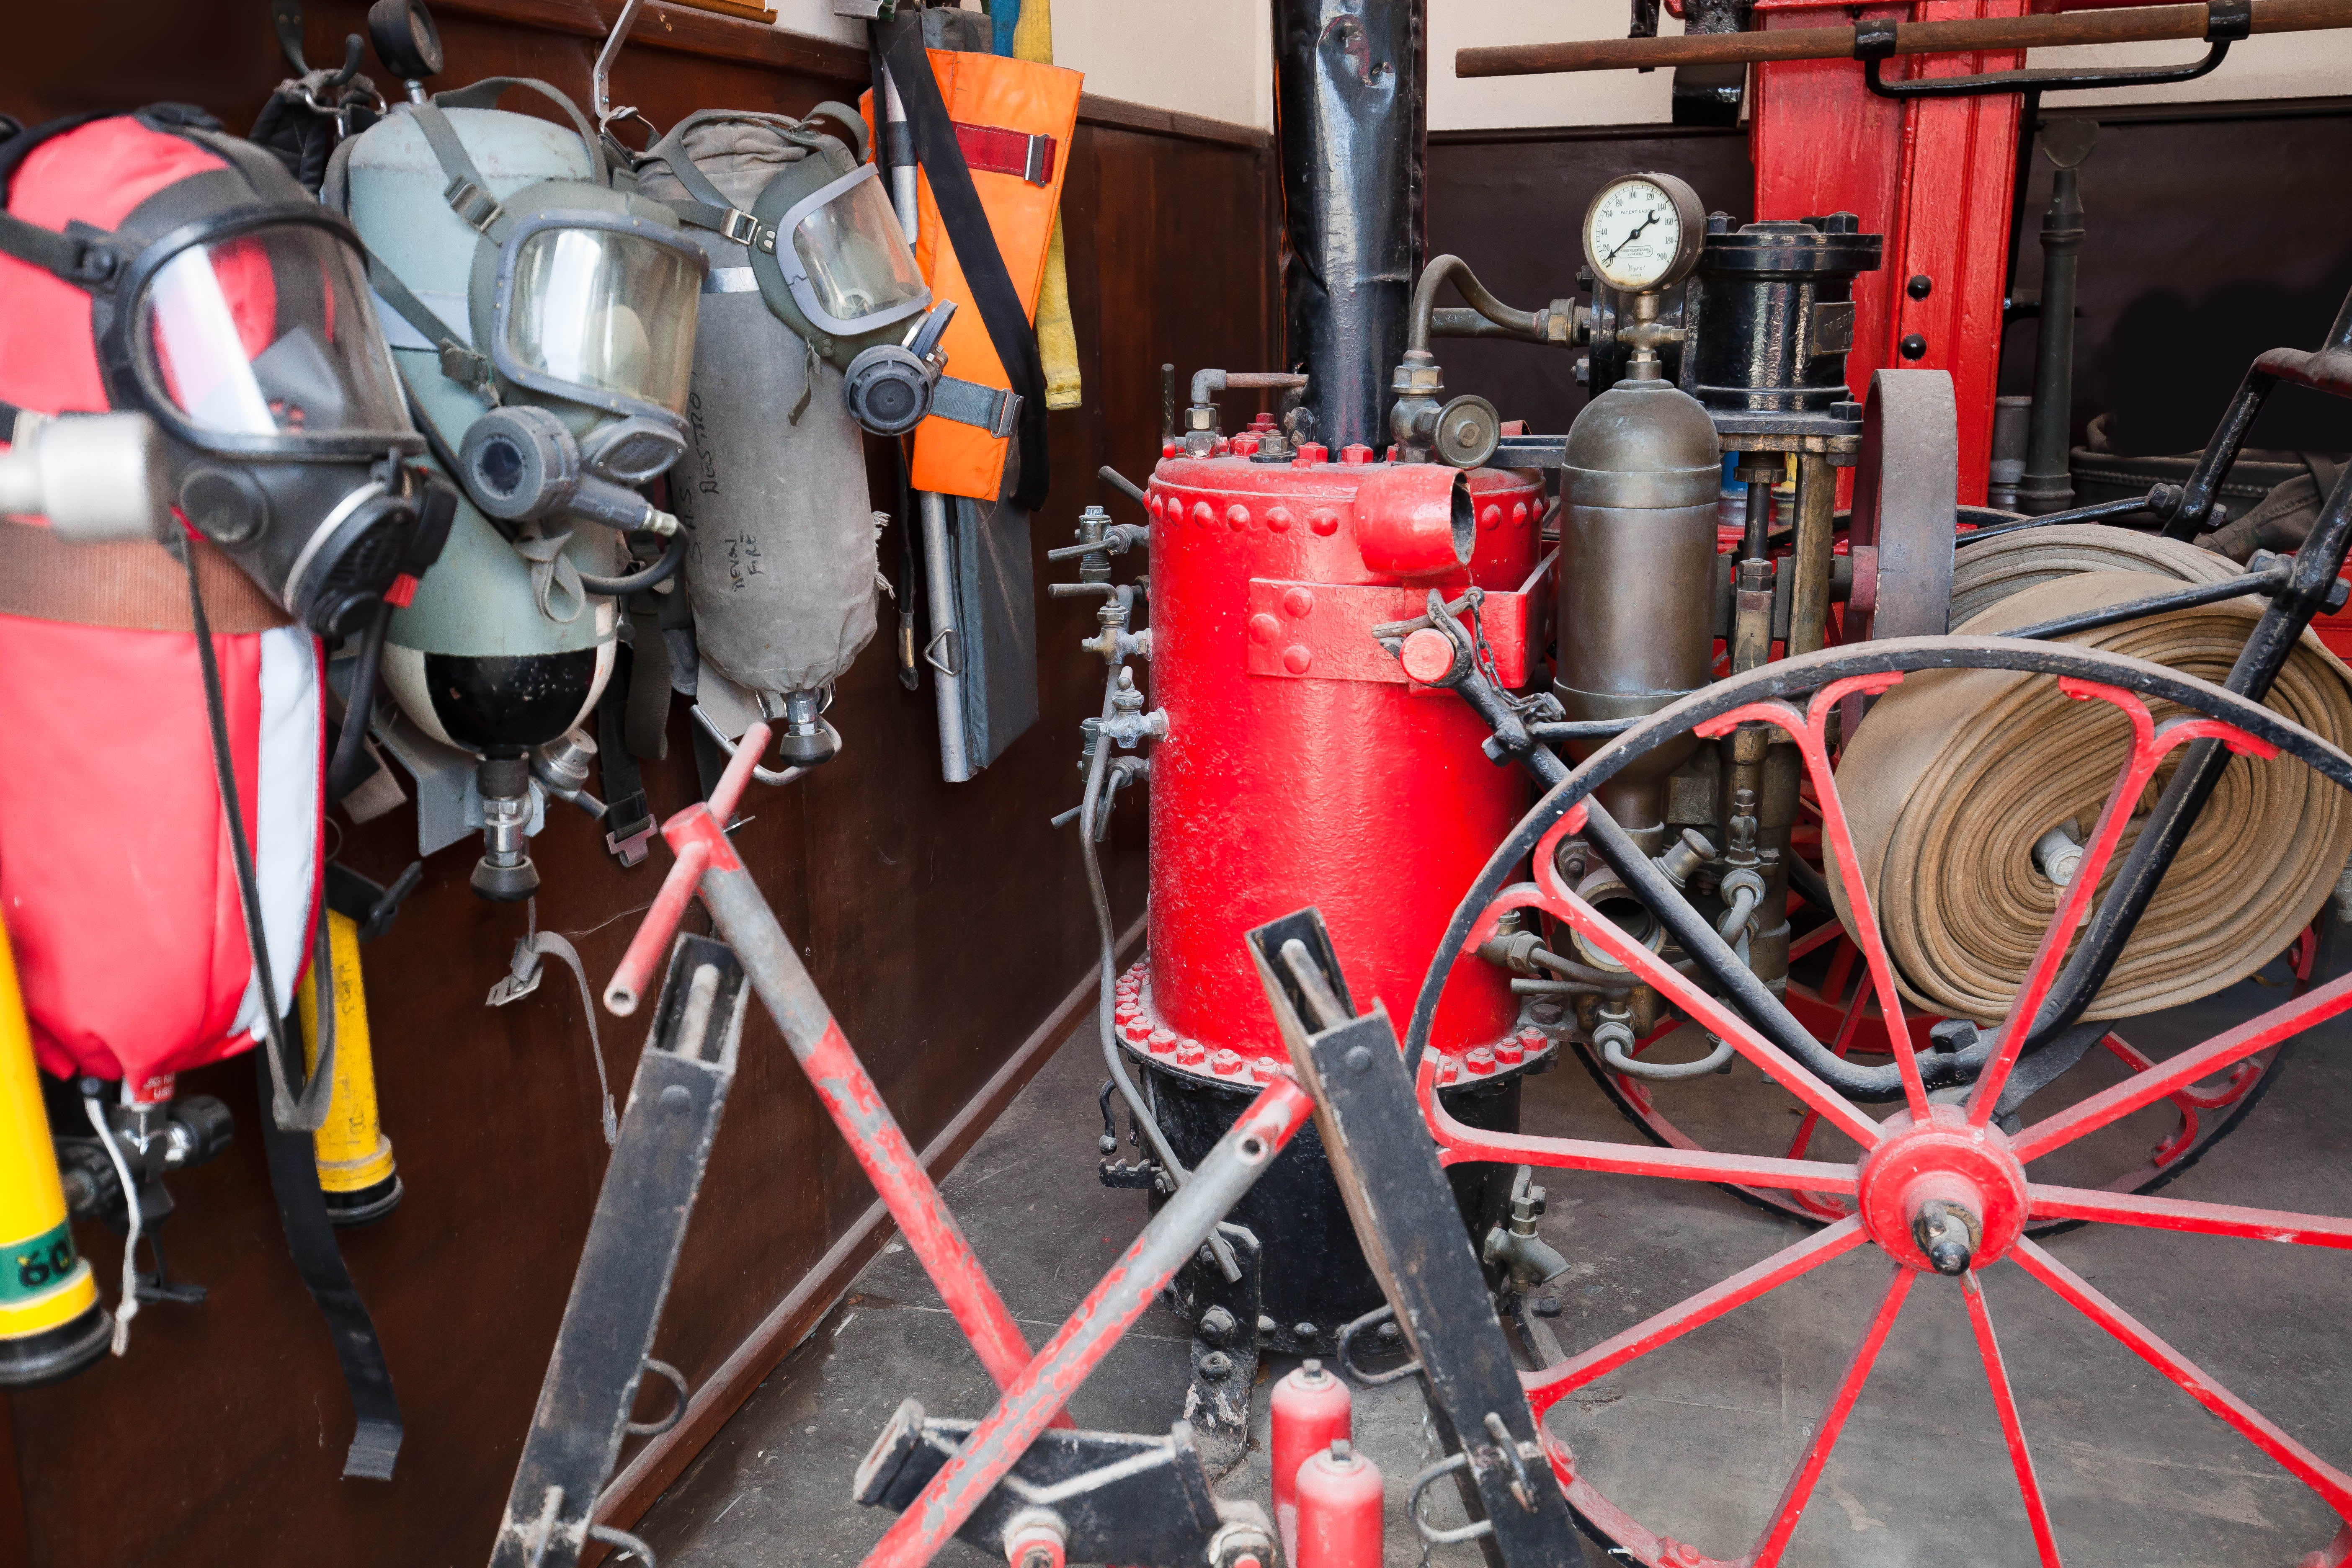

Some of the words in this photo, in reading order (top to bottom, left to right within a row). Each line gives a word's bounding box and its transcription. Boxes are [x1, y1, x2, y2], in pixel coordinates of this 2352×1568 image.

[1646, 192, 1654, 201] 120
[1615, 198, 1623, 206] 80
[1665, 236, 1674, 244] 180
[1657, 253, 1667, 261] 200
[689, 370, 719, 495] DESTRO
[744, 534, 765, 576] FIRE
[19, 1240, 70, 1286] 60
